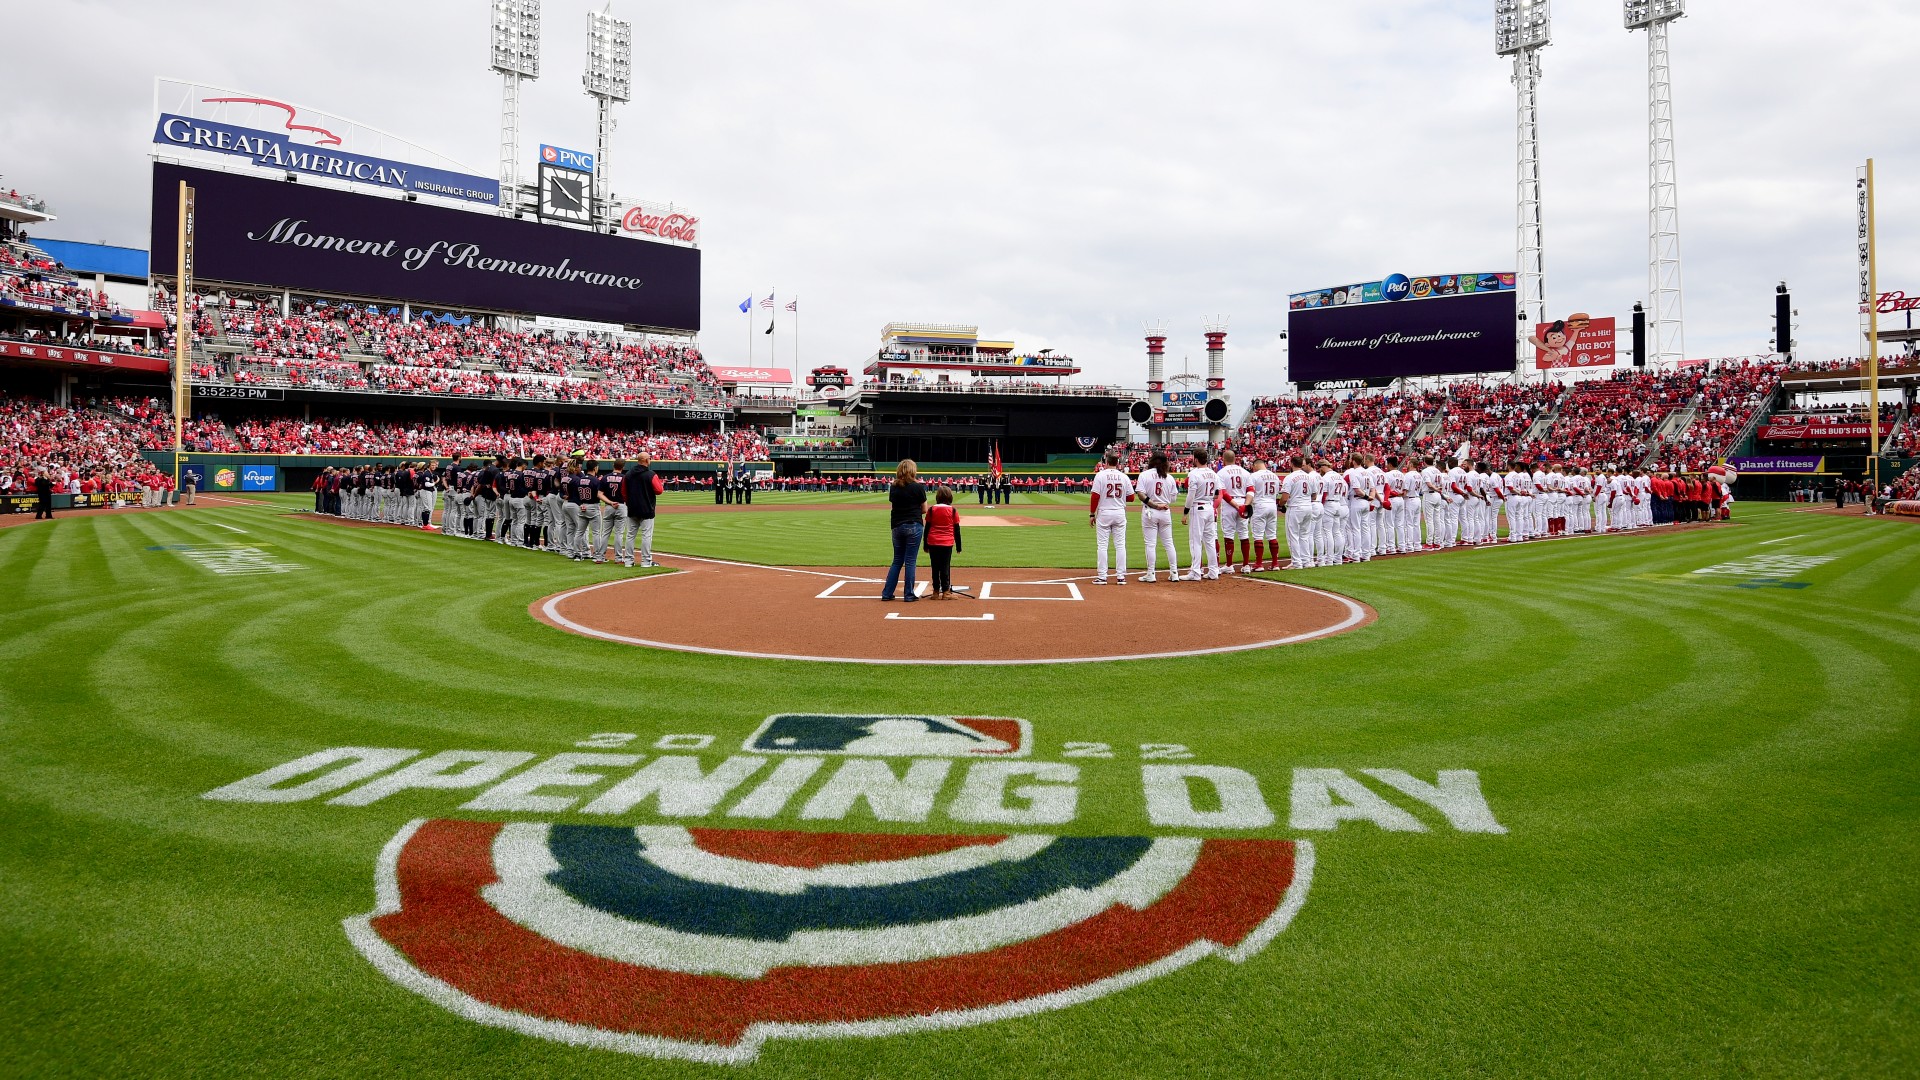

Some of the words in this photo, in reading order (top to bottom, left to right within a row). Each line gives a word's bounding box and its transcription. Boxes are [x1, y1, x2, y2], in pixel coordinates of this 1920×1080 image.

[560, 150, 592, 169] PNC
[415, 180, 464, 197] INSURANCE
[466, 188, 494, 201] GROUP
[622, 206, 699, 242] Coca-Cola
[246, 217, 399, 257] Moment
[402, 240, 448, 271] of
[444, 242, 643, 290] Remembrance
[1387, 281, 1408, 293] P&G
[1413, 282, 1430, 294] Tide
[568, 321, 606, 330] ULTIMATE
[1597, 329, 1611, 337] Hit!
[1315, 335, 1368, 350] Moment
[1369, 333, 1387, 349] of
[1381, 328, 1482, 348] Remembrance
[1576, 342, 1592, 351] BIG
[1593, 341, 1612, 350] BOY
[1044, 358, 1072, 366] TriHealth
[721, 369, 773, 378] Reds
[198, 386, 246, 398] 3:52:25
[248, 389, 267, 399] PM
[1179, 392, 1200, 401] PNC
[684, 411, 713, 420] 3:52:25
[713, 412, 725, 420] PM
[1769, 427, 1804, 436] Budweiser
[1828, 427, 1851, 435] BUD'S
[1867, 426, 1887, 434] YU.
[1739, 459, 1772, 471] planet
[1773, 458, 1814, 469] fitness
[243, 470, 274, 486] Kroger
[1230, 475, 1242, 490] 19
[578, 486, 592, 501] 38
[609, 482, 619, 497] 7
[1106, 483, 1123, 499] 25
[1155, 481, 1163, 497] 6
[1203, 481, 1215, 497] 12
[1264, 481, 1275, 496] 15
[1302, 481, 1308, 496] 9
[90, 493, 109, 504] MIKE
[573, 732, 715, 750] 20
[1062, 741, 1198, 759] 22
[200, 747, 1080, 826] OPENING
[1142, 763, 1509, 835] DAY
